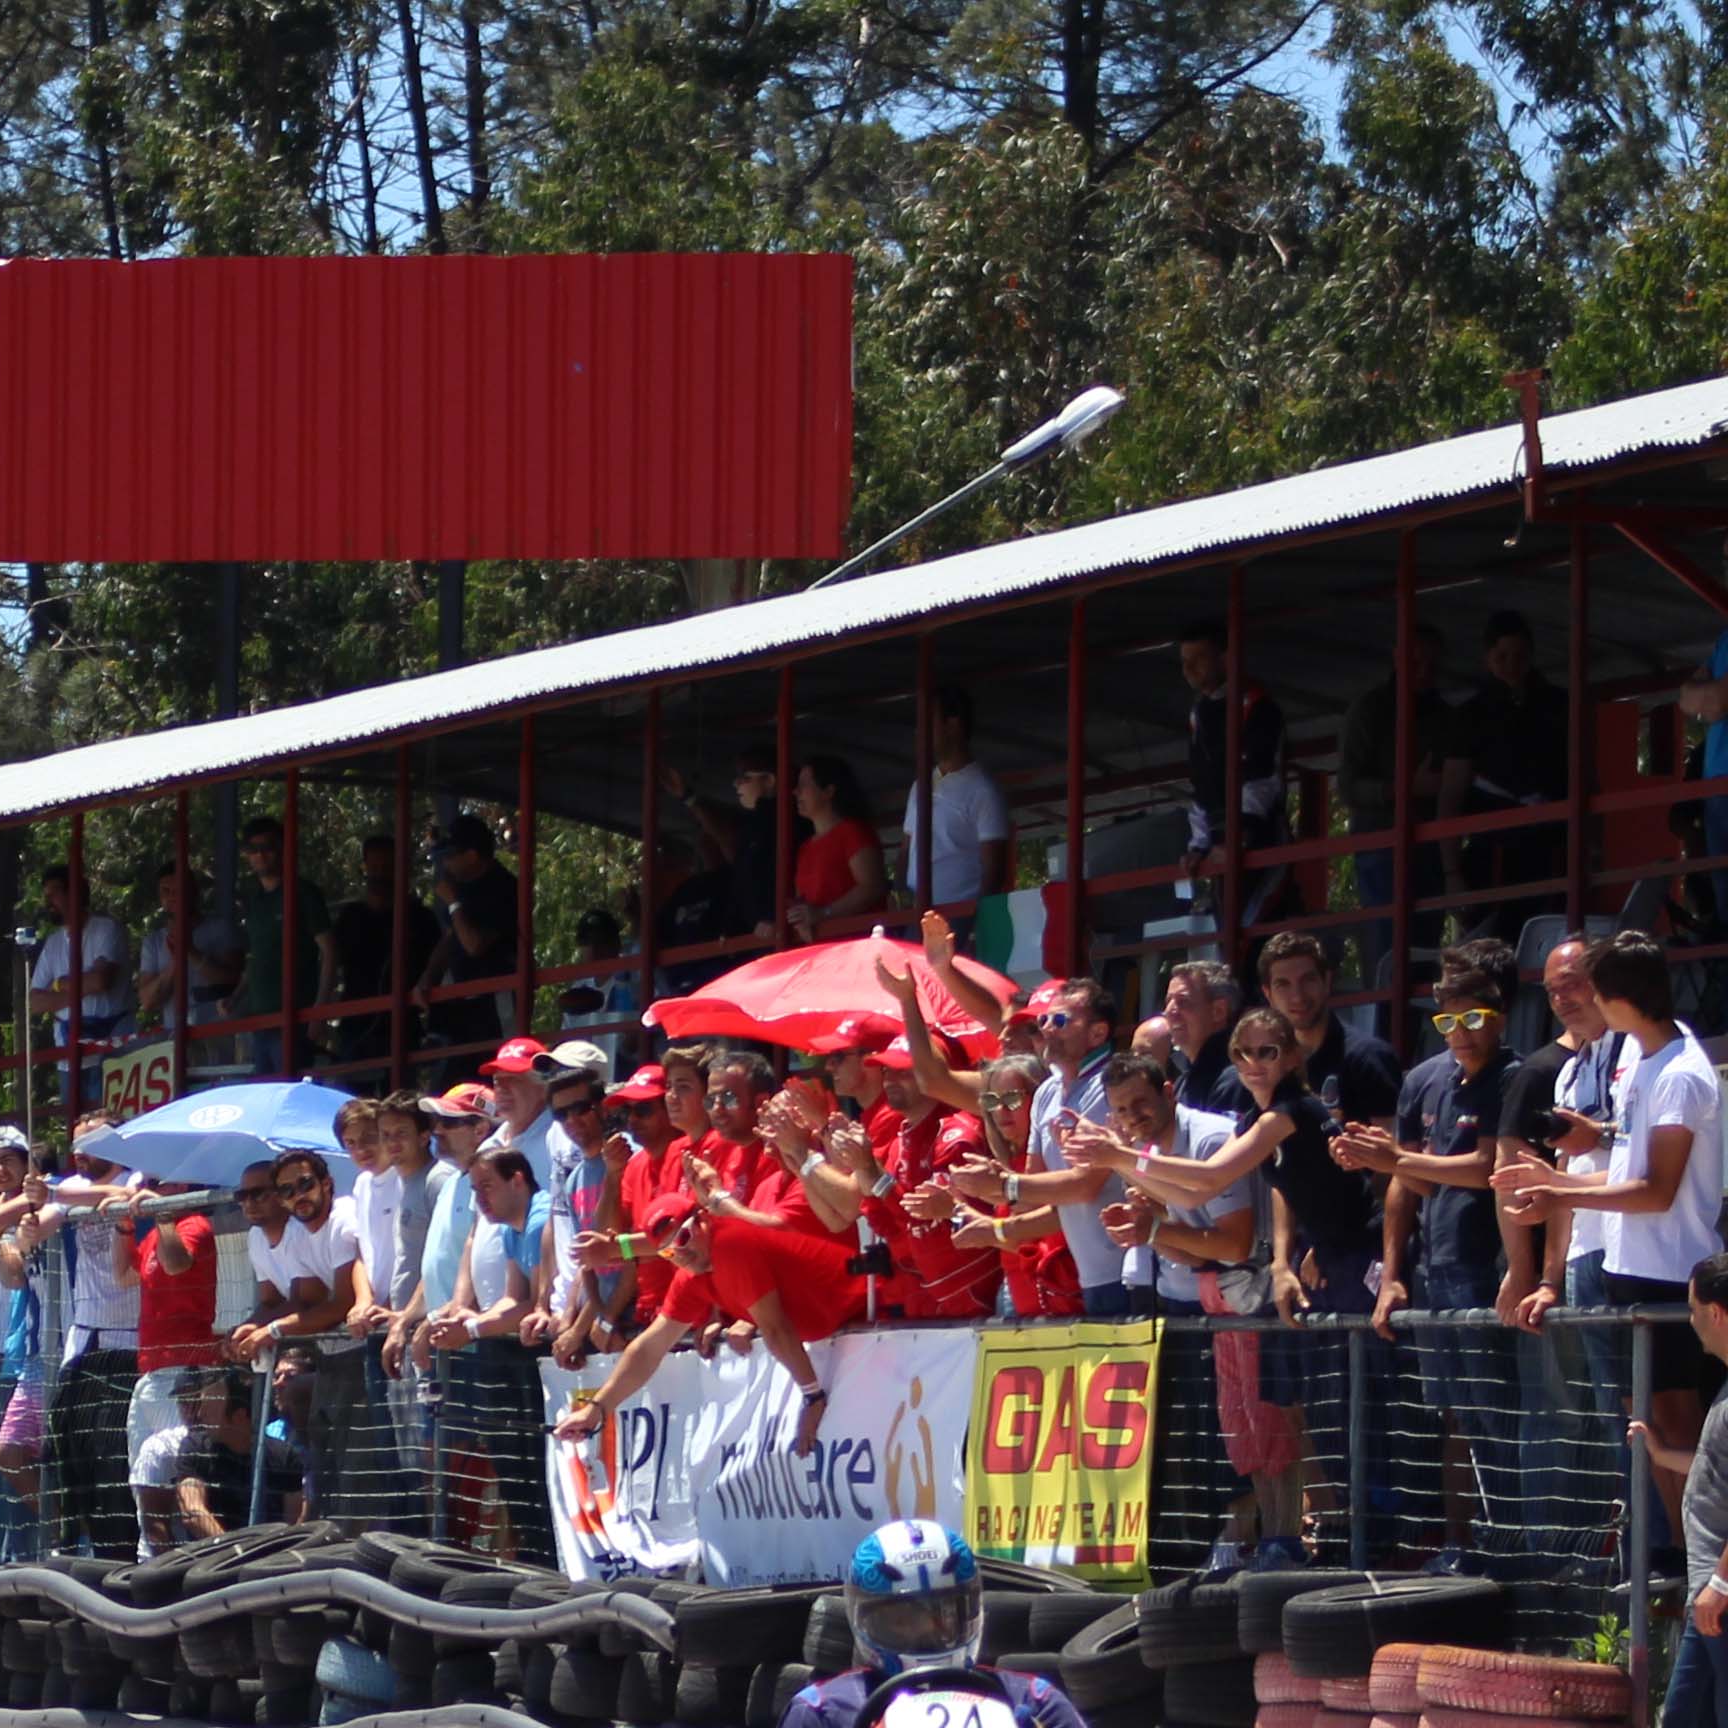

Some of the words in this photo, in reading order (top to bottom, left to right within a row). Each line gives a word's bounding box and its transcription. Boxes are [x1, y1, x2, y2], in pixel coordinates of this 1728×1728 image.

[104, 1056, 171, 1114] GAS
[982, 1361, 1150, 1475] GAS
[976, 1504, 1064, 1542] RACING
[1073, 1501, 1144, 1539] TEAM
